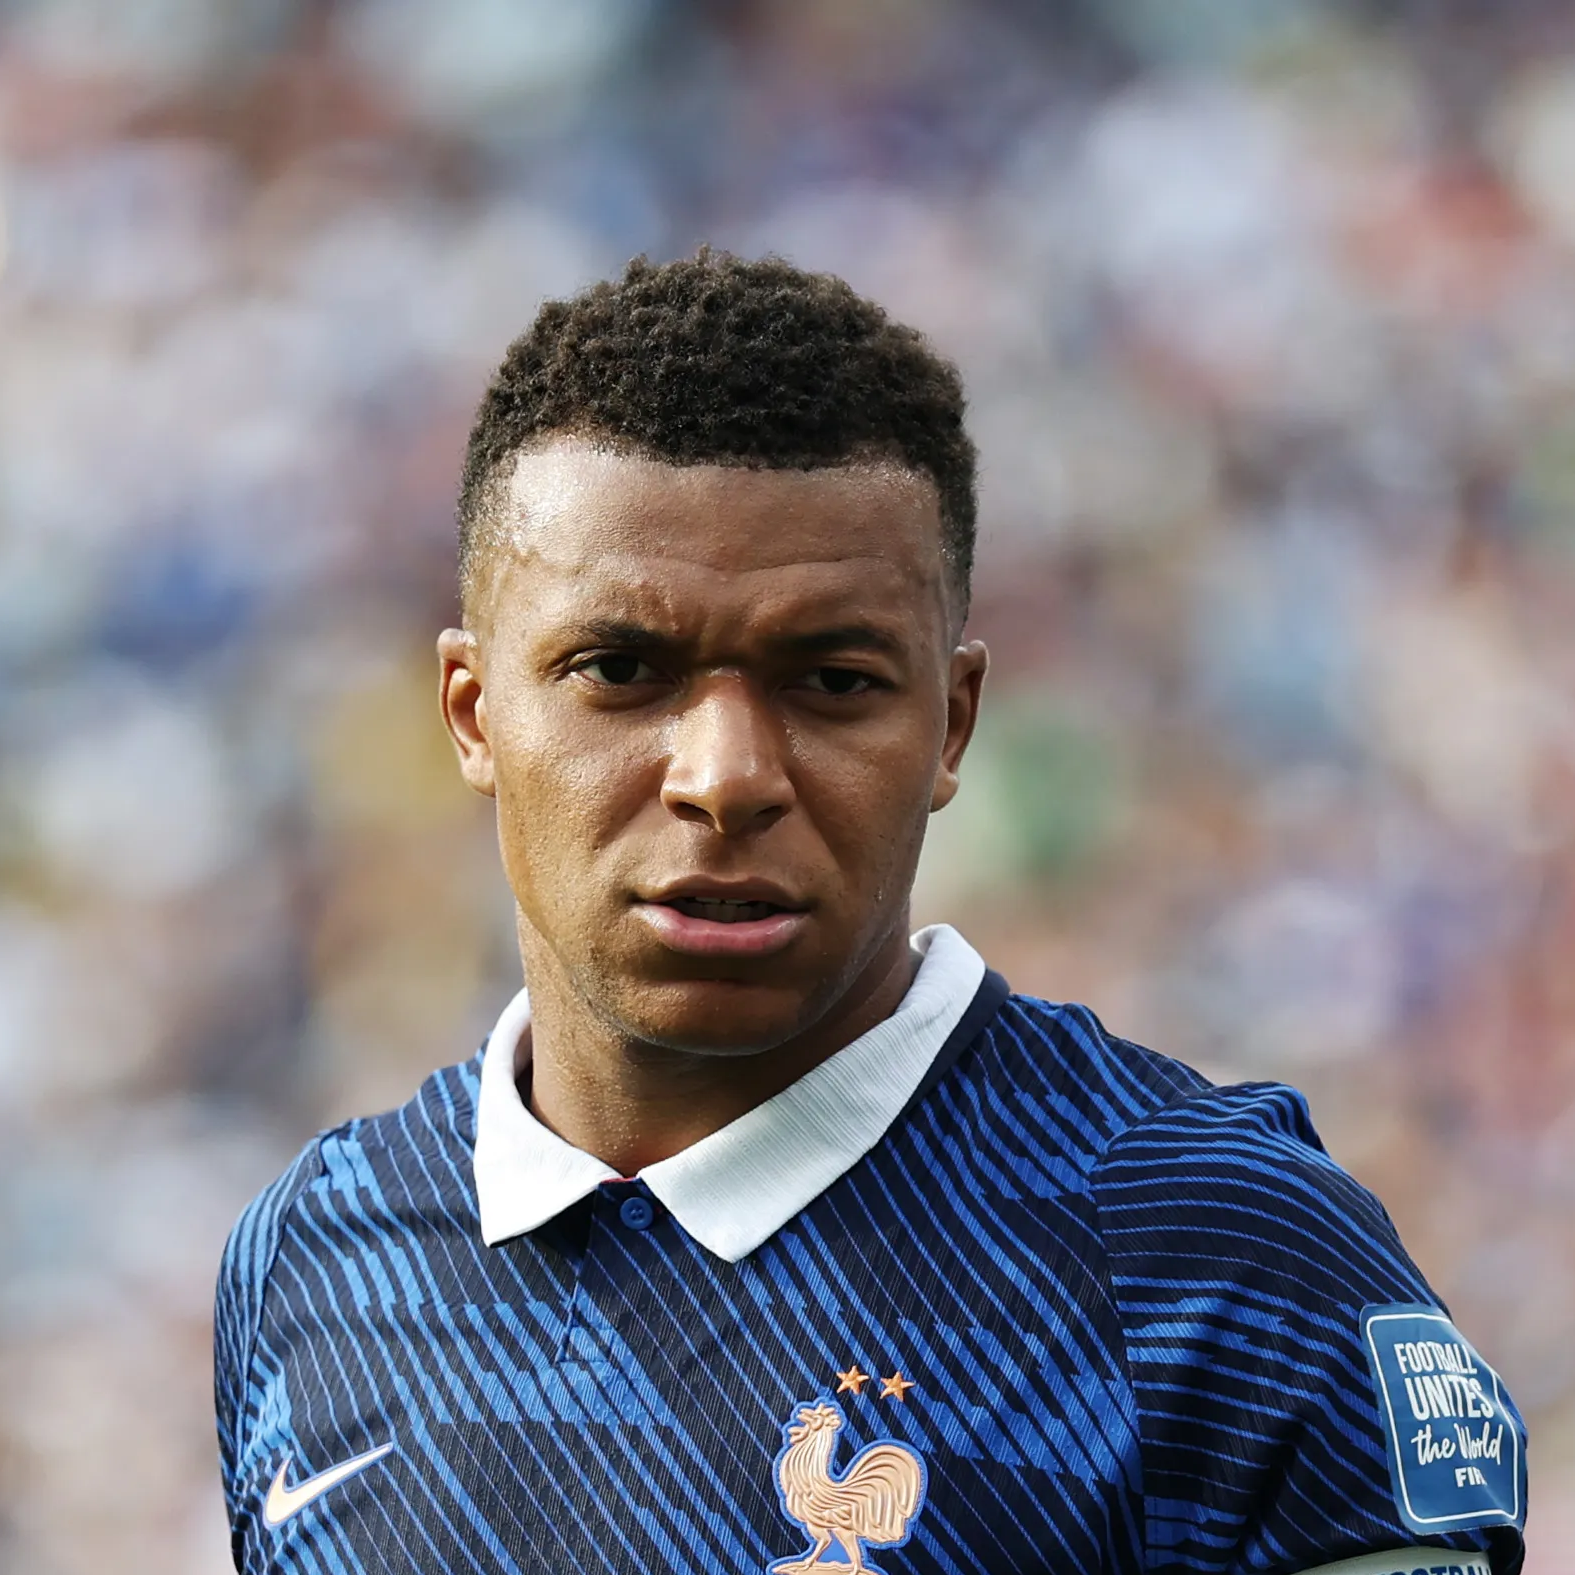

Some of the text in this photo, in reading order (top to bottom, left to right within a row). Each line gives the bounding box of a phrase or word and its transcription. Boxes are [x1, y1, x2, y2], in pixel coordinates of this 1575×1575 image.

[1393, 1341, 1478, 1374] FOOTBALL
[1404, 1374, 1495, 1421] UNITES
[1411, 1421, 1504, 1466] the World
